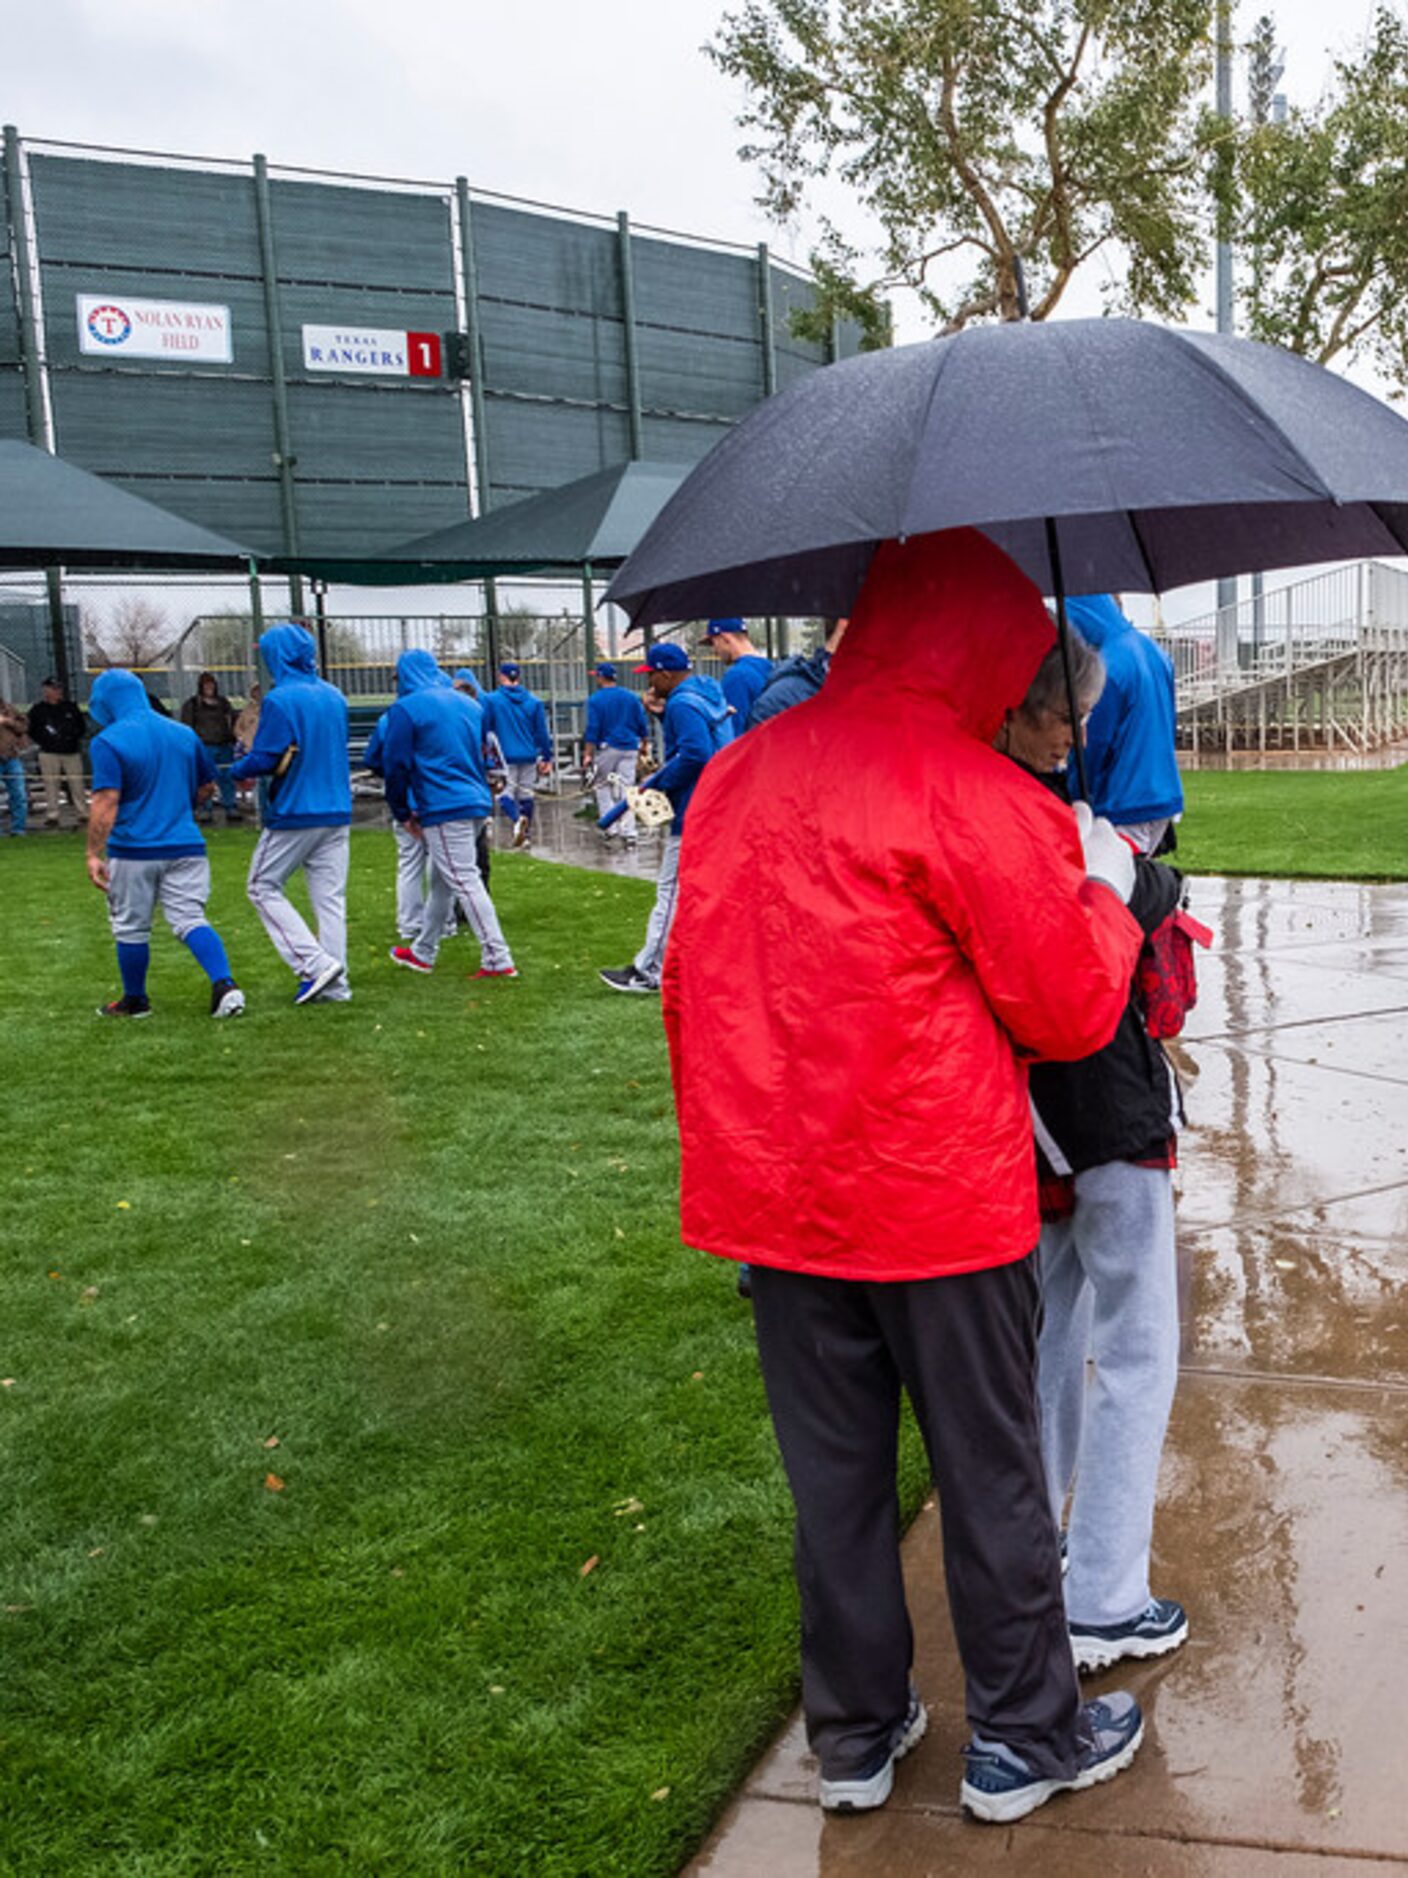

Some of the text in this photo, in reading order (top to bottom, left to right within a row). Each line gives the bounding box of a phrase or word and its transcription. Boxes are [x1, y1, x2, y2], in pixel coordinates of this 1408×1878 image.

[101, 317, 116, 334] T
[135, 310, 182, 328] NOLAN
[185, 313, 223, 330] RYAN
[162, 332, 199, 350] FIELD
[310, 346, 404, 368] RANGERS
[418, 343, 431, 369] 1
